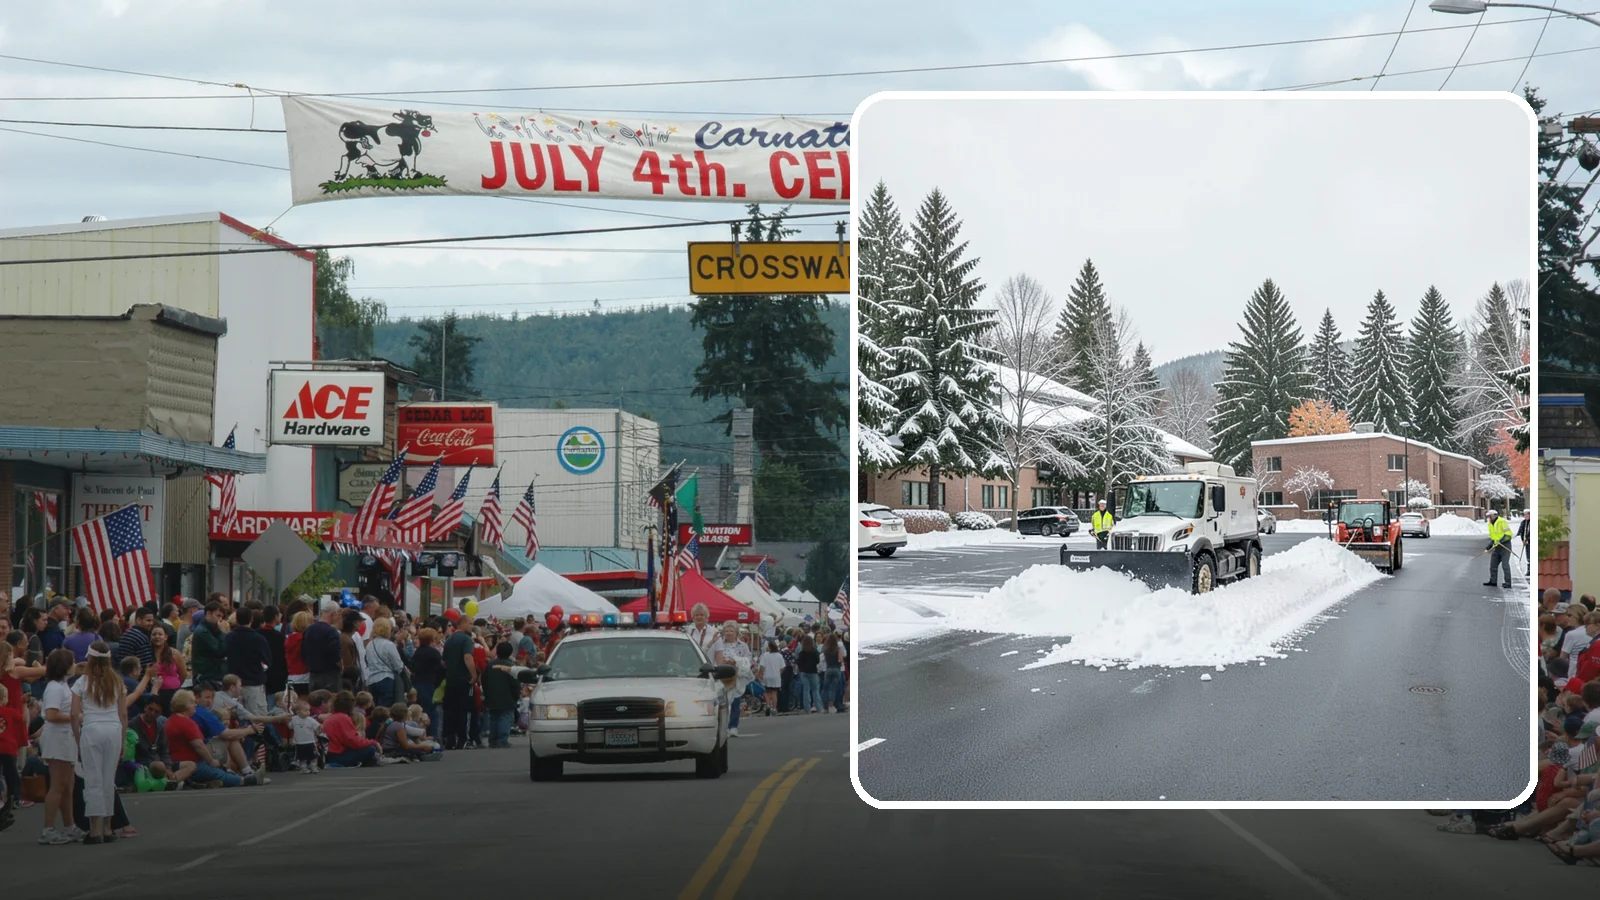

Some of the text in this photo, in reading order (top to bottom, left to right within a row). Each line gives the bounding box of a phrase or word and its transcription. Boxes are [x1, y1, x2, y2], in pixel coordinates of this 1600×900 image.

[481, 141, 605, 192] JULY
[632, 150, 746, 198] 4th.
[696, 253, 850, 281] CROSSWA
[282, 380, 373, 420] ACE
[405, 409, 485, 422] CEDAR LOG
[283, 421, 371, 437] Hardware
[416, 428, 477, 446] Coca-Cola
[96, 484, 124, 495] Vincent
[126, 486, 136, 495] de
[138, 486, 155, 496] Paul
[688, 526, 741, 535] CRNATION
[699, 535, 730, 543] GLASS
